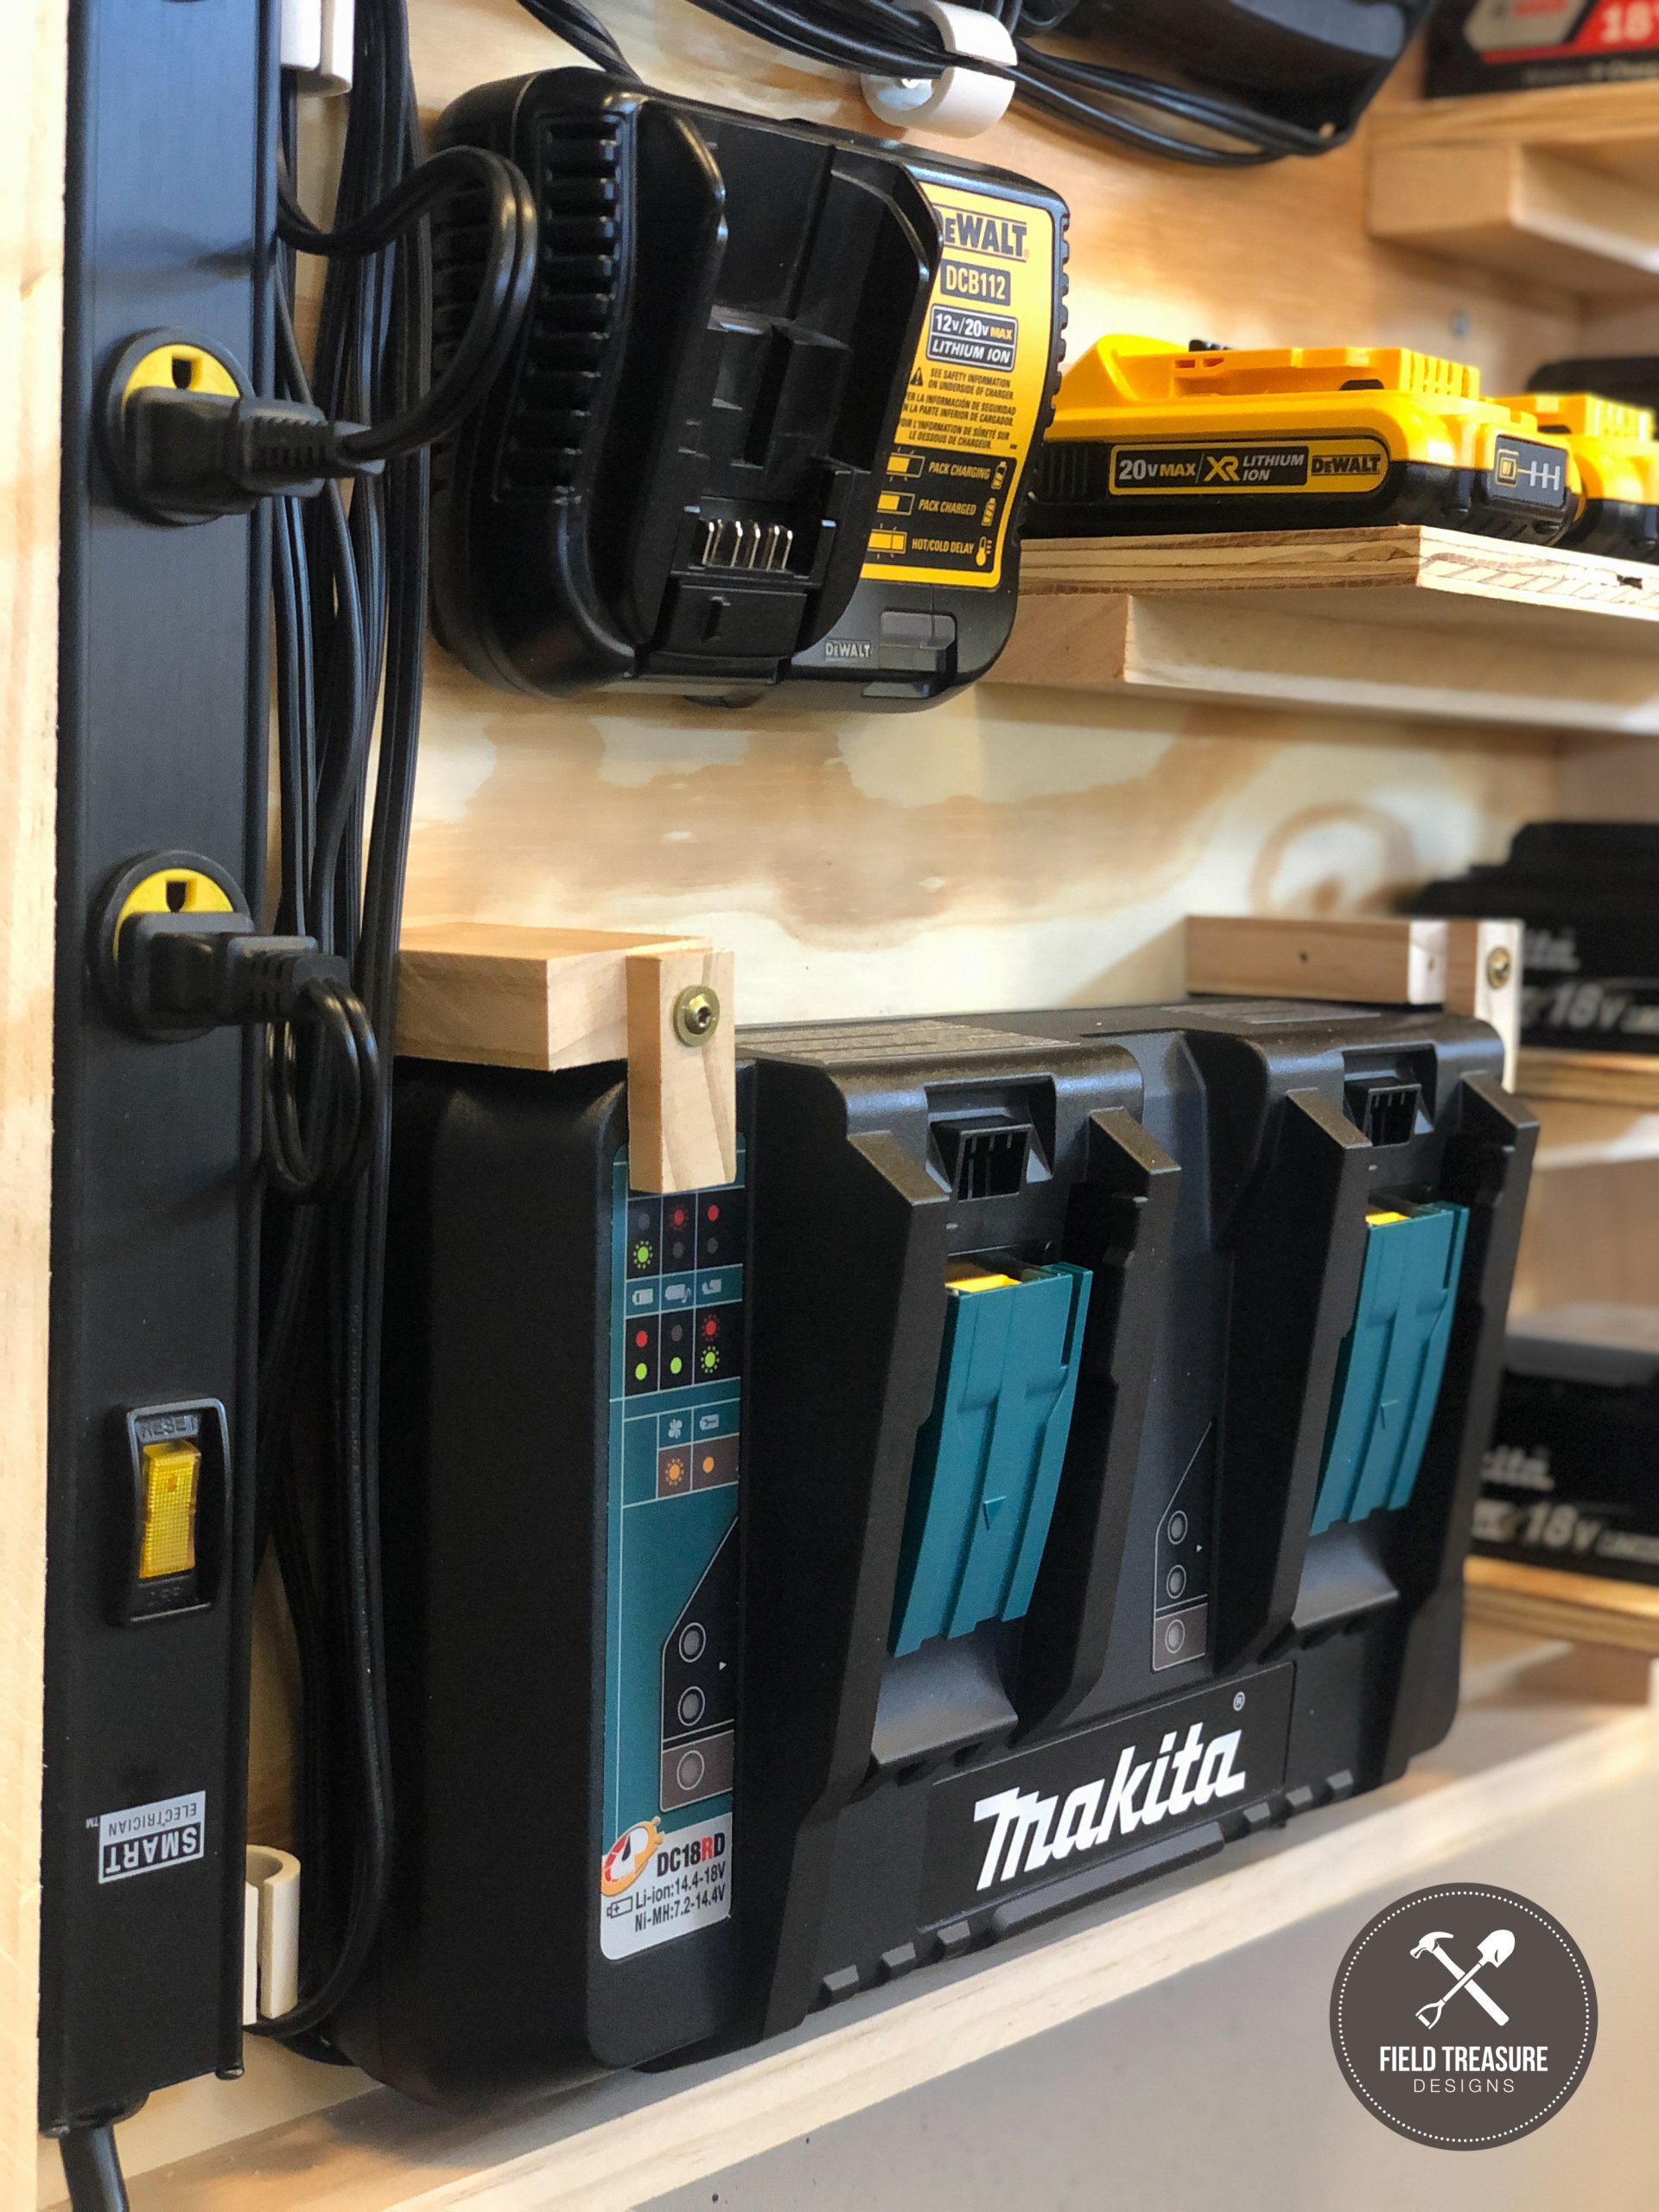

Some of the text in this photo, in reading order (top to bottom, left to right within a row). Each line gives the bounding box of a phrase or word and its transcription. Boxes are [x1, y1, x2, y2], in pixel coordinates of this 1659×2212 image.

[945, 264, 1007, 300] DCB112
[990, 326, 1012, 341] MAX
[931, 340, 1012, 364] LITHIUM ION
[928, 379, 938, 389] ON
[939, 380, 975, 395] UNDERSIDE
[976, 385, 984, 396] OF
[931, 368, 1011, 388] SEE SAFETY INFORMATION
[909, 404, 918, 413] LA
[919, 405, 939, 416] PARTE
[940, 408, 969, 421] INFERIOR
[969, 412, 978, 423] DE
[917, 392, 925, 403] LA
[925, 394, 970, 410] INFORMACIÓN
[972, 401, 981, 411] DE
[981, 403, 1016, 416] SEGURIDAD
[909, 430, 917, 440] LE
[917, 431, 947, 444] DESSOUS
[948, 435, 957, 446] DE
[912, 420, 963, 435] L'INFORMATION
[963, 426, 971, 436] DE
[997, 431, 1009, 441] SUR
[928, 461, 991, 480] PACK CHARGING
[1204, 455, 1241, 482] XR
[1243, 454, 1305, 467] LITHIUM
[1243, 469, 1270, 482] ION
[918, 499, 976, 516] PACK CHARGED
[912, 537, 976, 555] HOT/COLD DELAY
[136, 1414, 199, 1441] RESET
[108, 1802, 197, 1838] ELECTRICIAN
[105, 1826, 199, 1875] SMART
[657, 1832, 726, 1878] DC18RD
